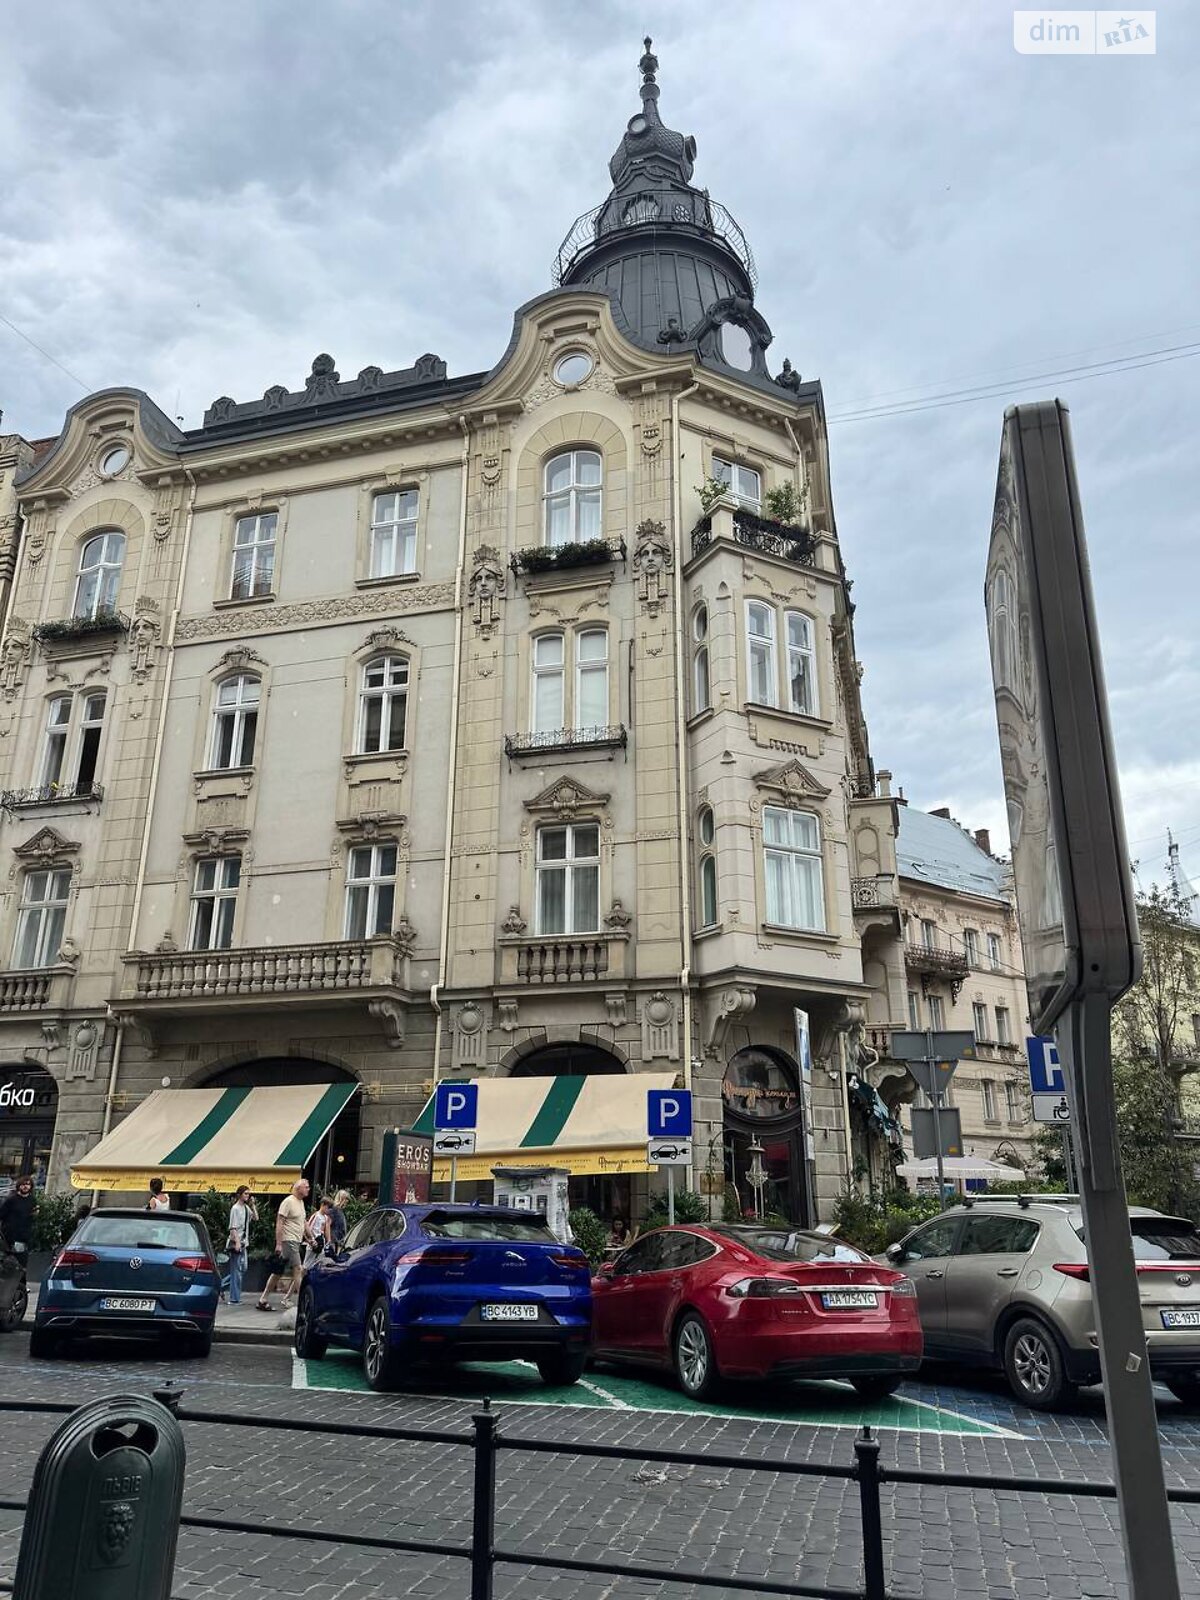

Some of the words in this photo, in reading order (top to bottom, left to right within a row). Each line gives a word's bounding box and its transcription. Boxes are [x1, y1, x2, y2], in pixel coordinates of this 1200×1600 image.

[446, 1092, 467, 1121] P
[659, 1097, 680, 1128] P
[104, 1299, 118, 1308] BC
[140, 1300, 155, 1309] PT
[486, 1305, 501, 1316] BC
[501, 1305, 522, 1316] 4143
[523, 1306, 537, 1317] YB
[1168, 1313, 1182, 1324] BC
